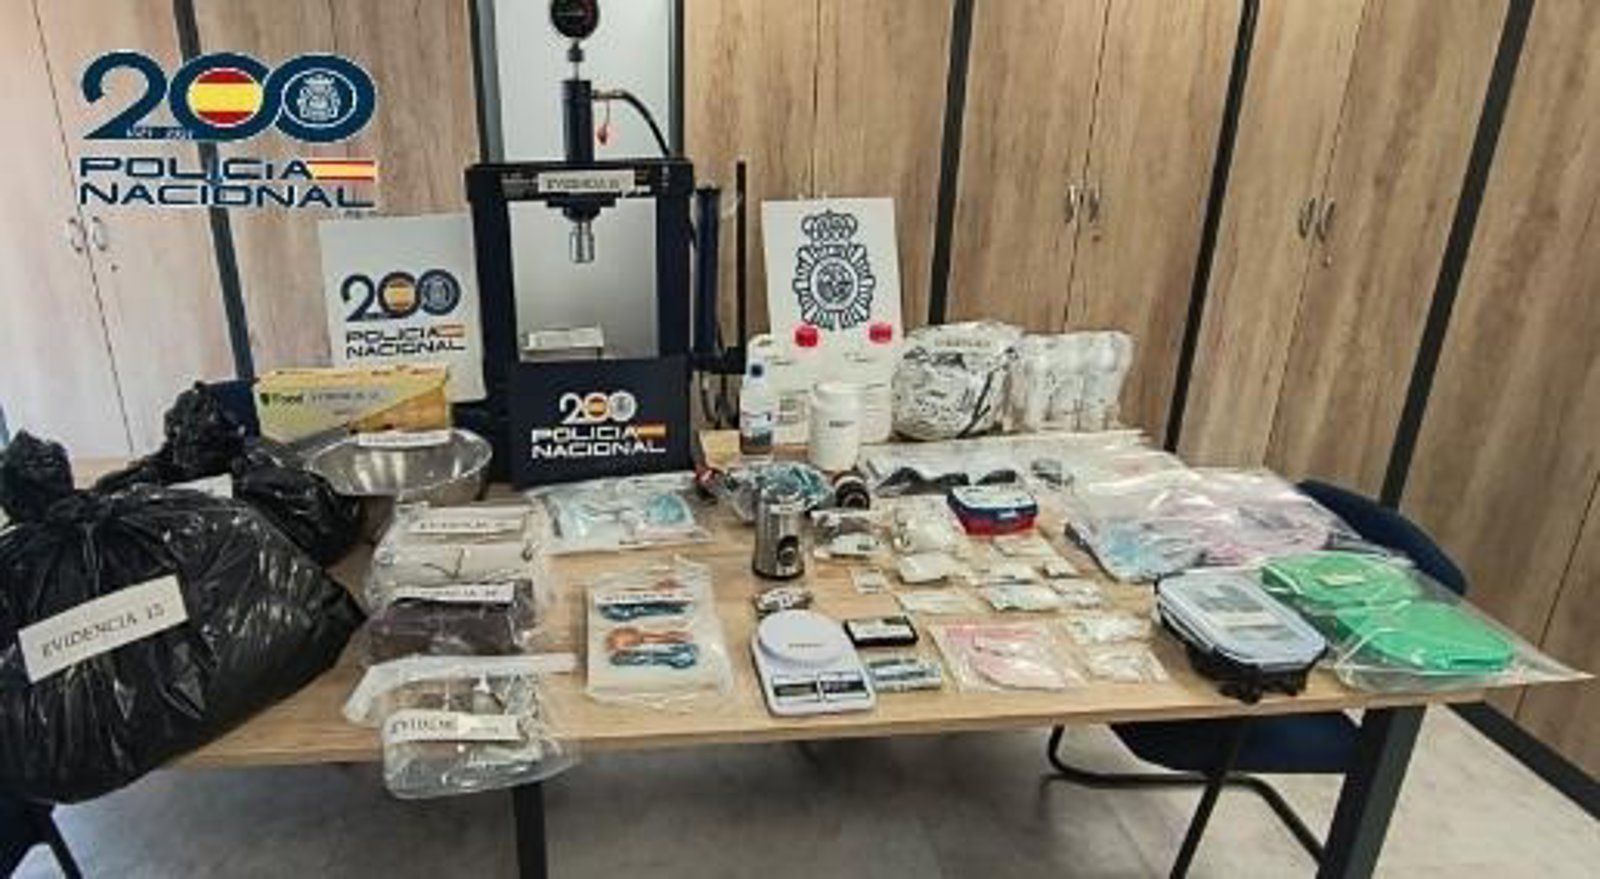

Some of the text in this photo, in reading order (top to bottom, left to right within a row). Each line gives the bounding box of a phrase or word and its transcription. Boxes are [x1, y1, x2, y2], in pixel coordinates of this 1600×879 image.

[340, 269, 461, 322] 200
[346, 341, 466, 359] NACIONAL
[559, 391, 637, 424] 200
[531, 439, 666, 459] NACIONAL
[42, 612, 138, 658] EVIDENCIA
